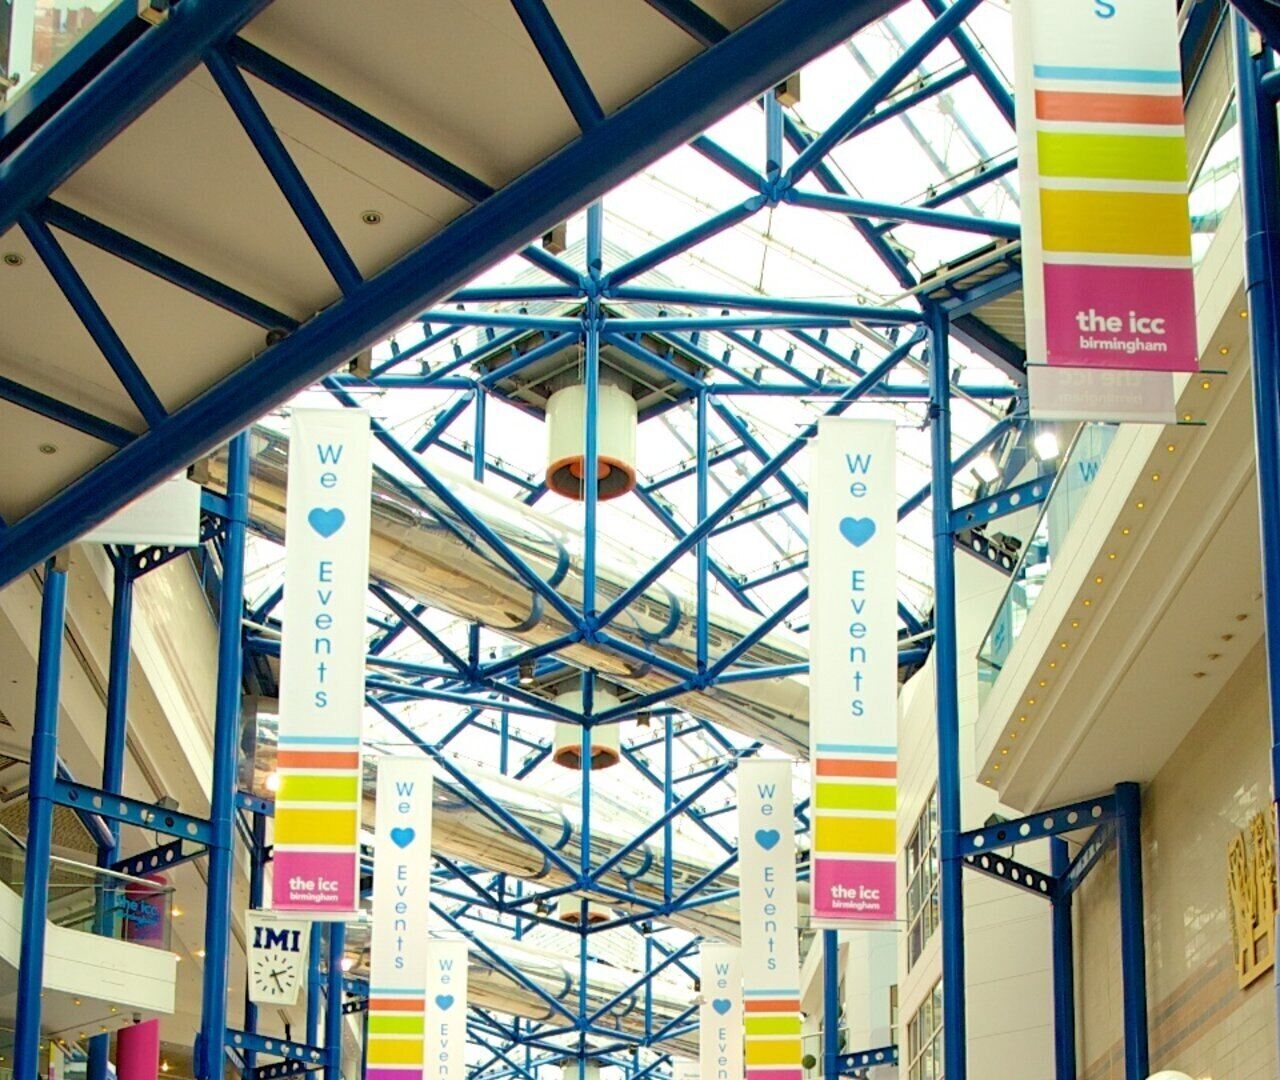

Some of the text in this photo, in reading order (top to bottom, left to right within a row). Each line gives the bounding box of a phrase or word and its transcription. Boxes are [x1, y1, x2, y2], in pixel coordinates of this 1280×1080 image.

[1076, 308, 1166, 335] the icc
[1079, 336, 1167, 353] birmingham
[316, 444, 343, 489] We
[846, 453, 872, 499] We
[314, 560, 333, 709] Events
[849, 569, 866, 717] Events
[396, 781, 415, 814] We
[757, 783, 776, 816] We
[288, 877, 339, 893] the icc
[289, 893, 339, 903] birmingham
[831, 884, 880, 900] the icc
[394, 865, 407, 970] Events
[831, 899, 880, 911] birmingham
[763, 867, 777, 971] Events
[253, 926, 301, 952] IMI
[438, 958, 453, 985] We
[714, 962, 730, 989] We
